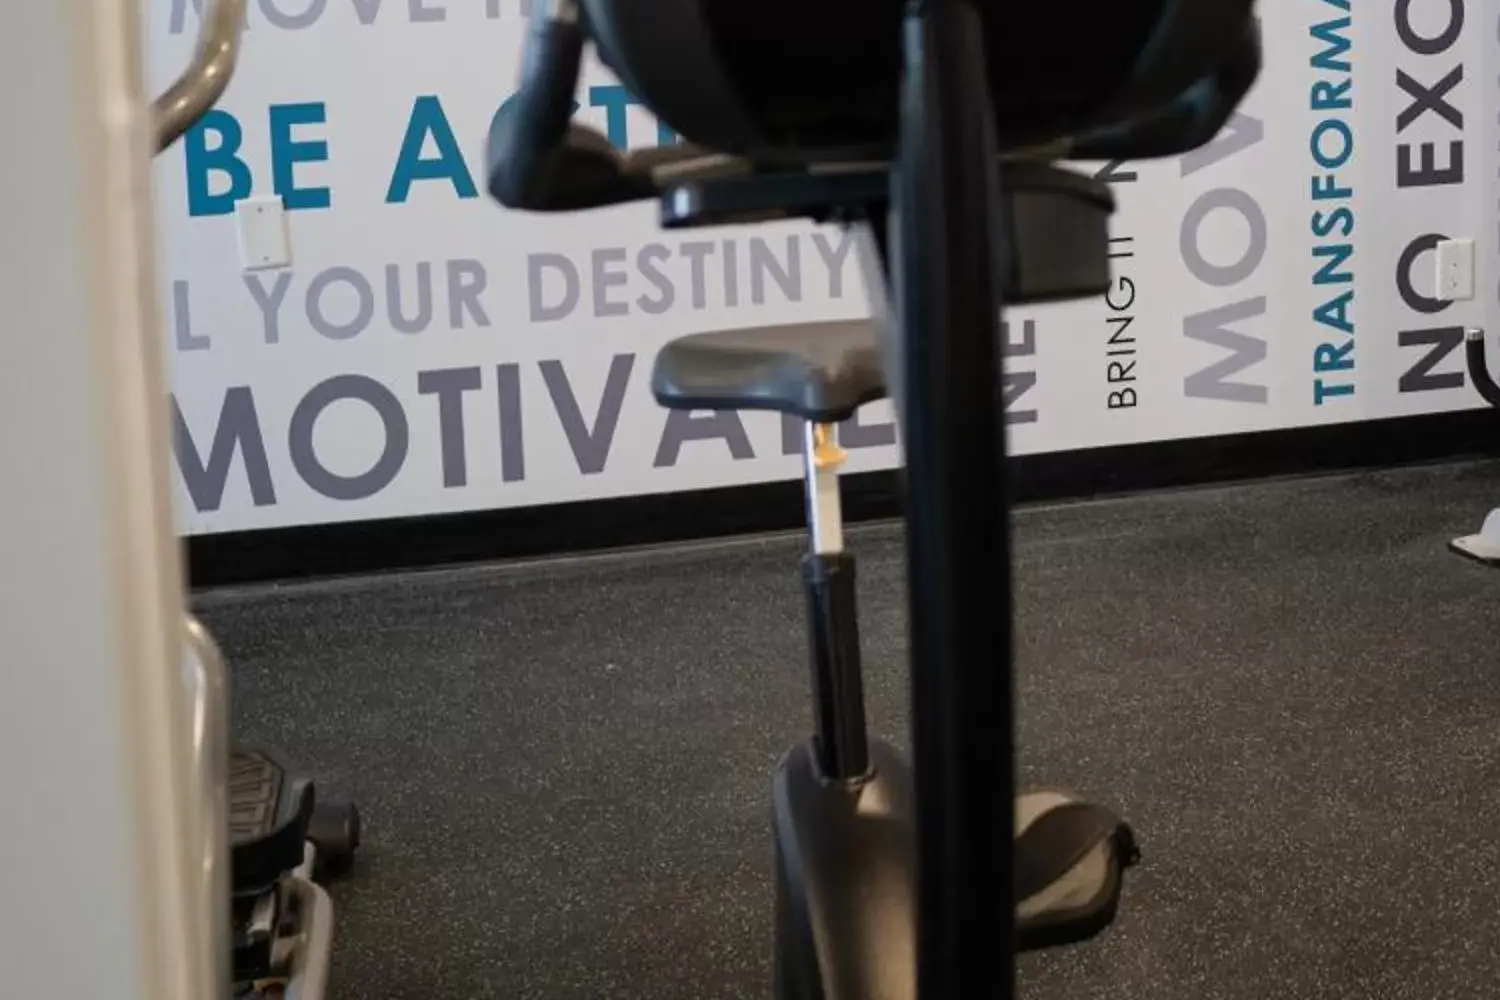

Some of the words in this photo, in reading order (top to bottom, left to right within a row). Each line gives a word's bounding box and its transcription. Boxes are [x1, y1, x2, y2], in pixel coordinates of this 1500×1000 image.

[183, 101, 331, 217] BE
[242, 257, 492, 345] YOUR
[527, 233, 857, 322] DESTINY
[1105, 276, 1137, 409] BRING
[1395, 232, 1465, 393] NO
